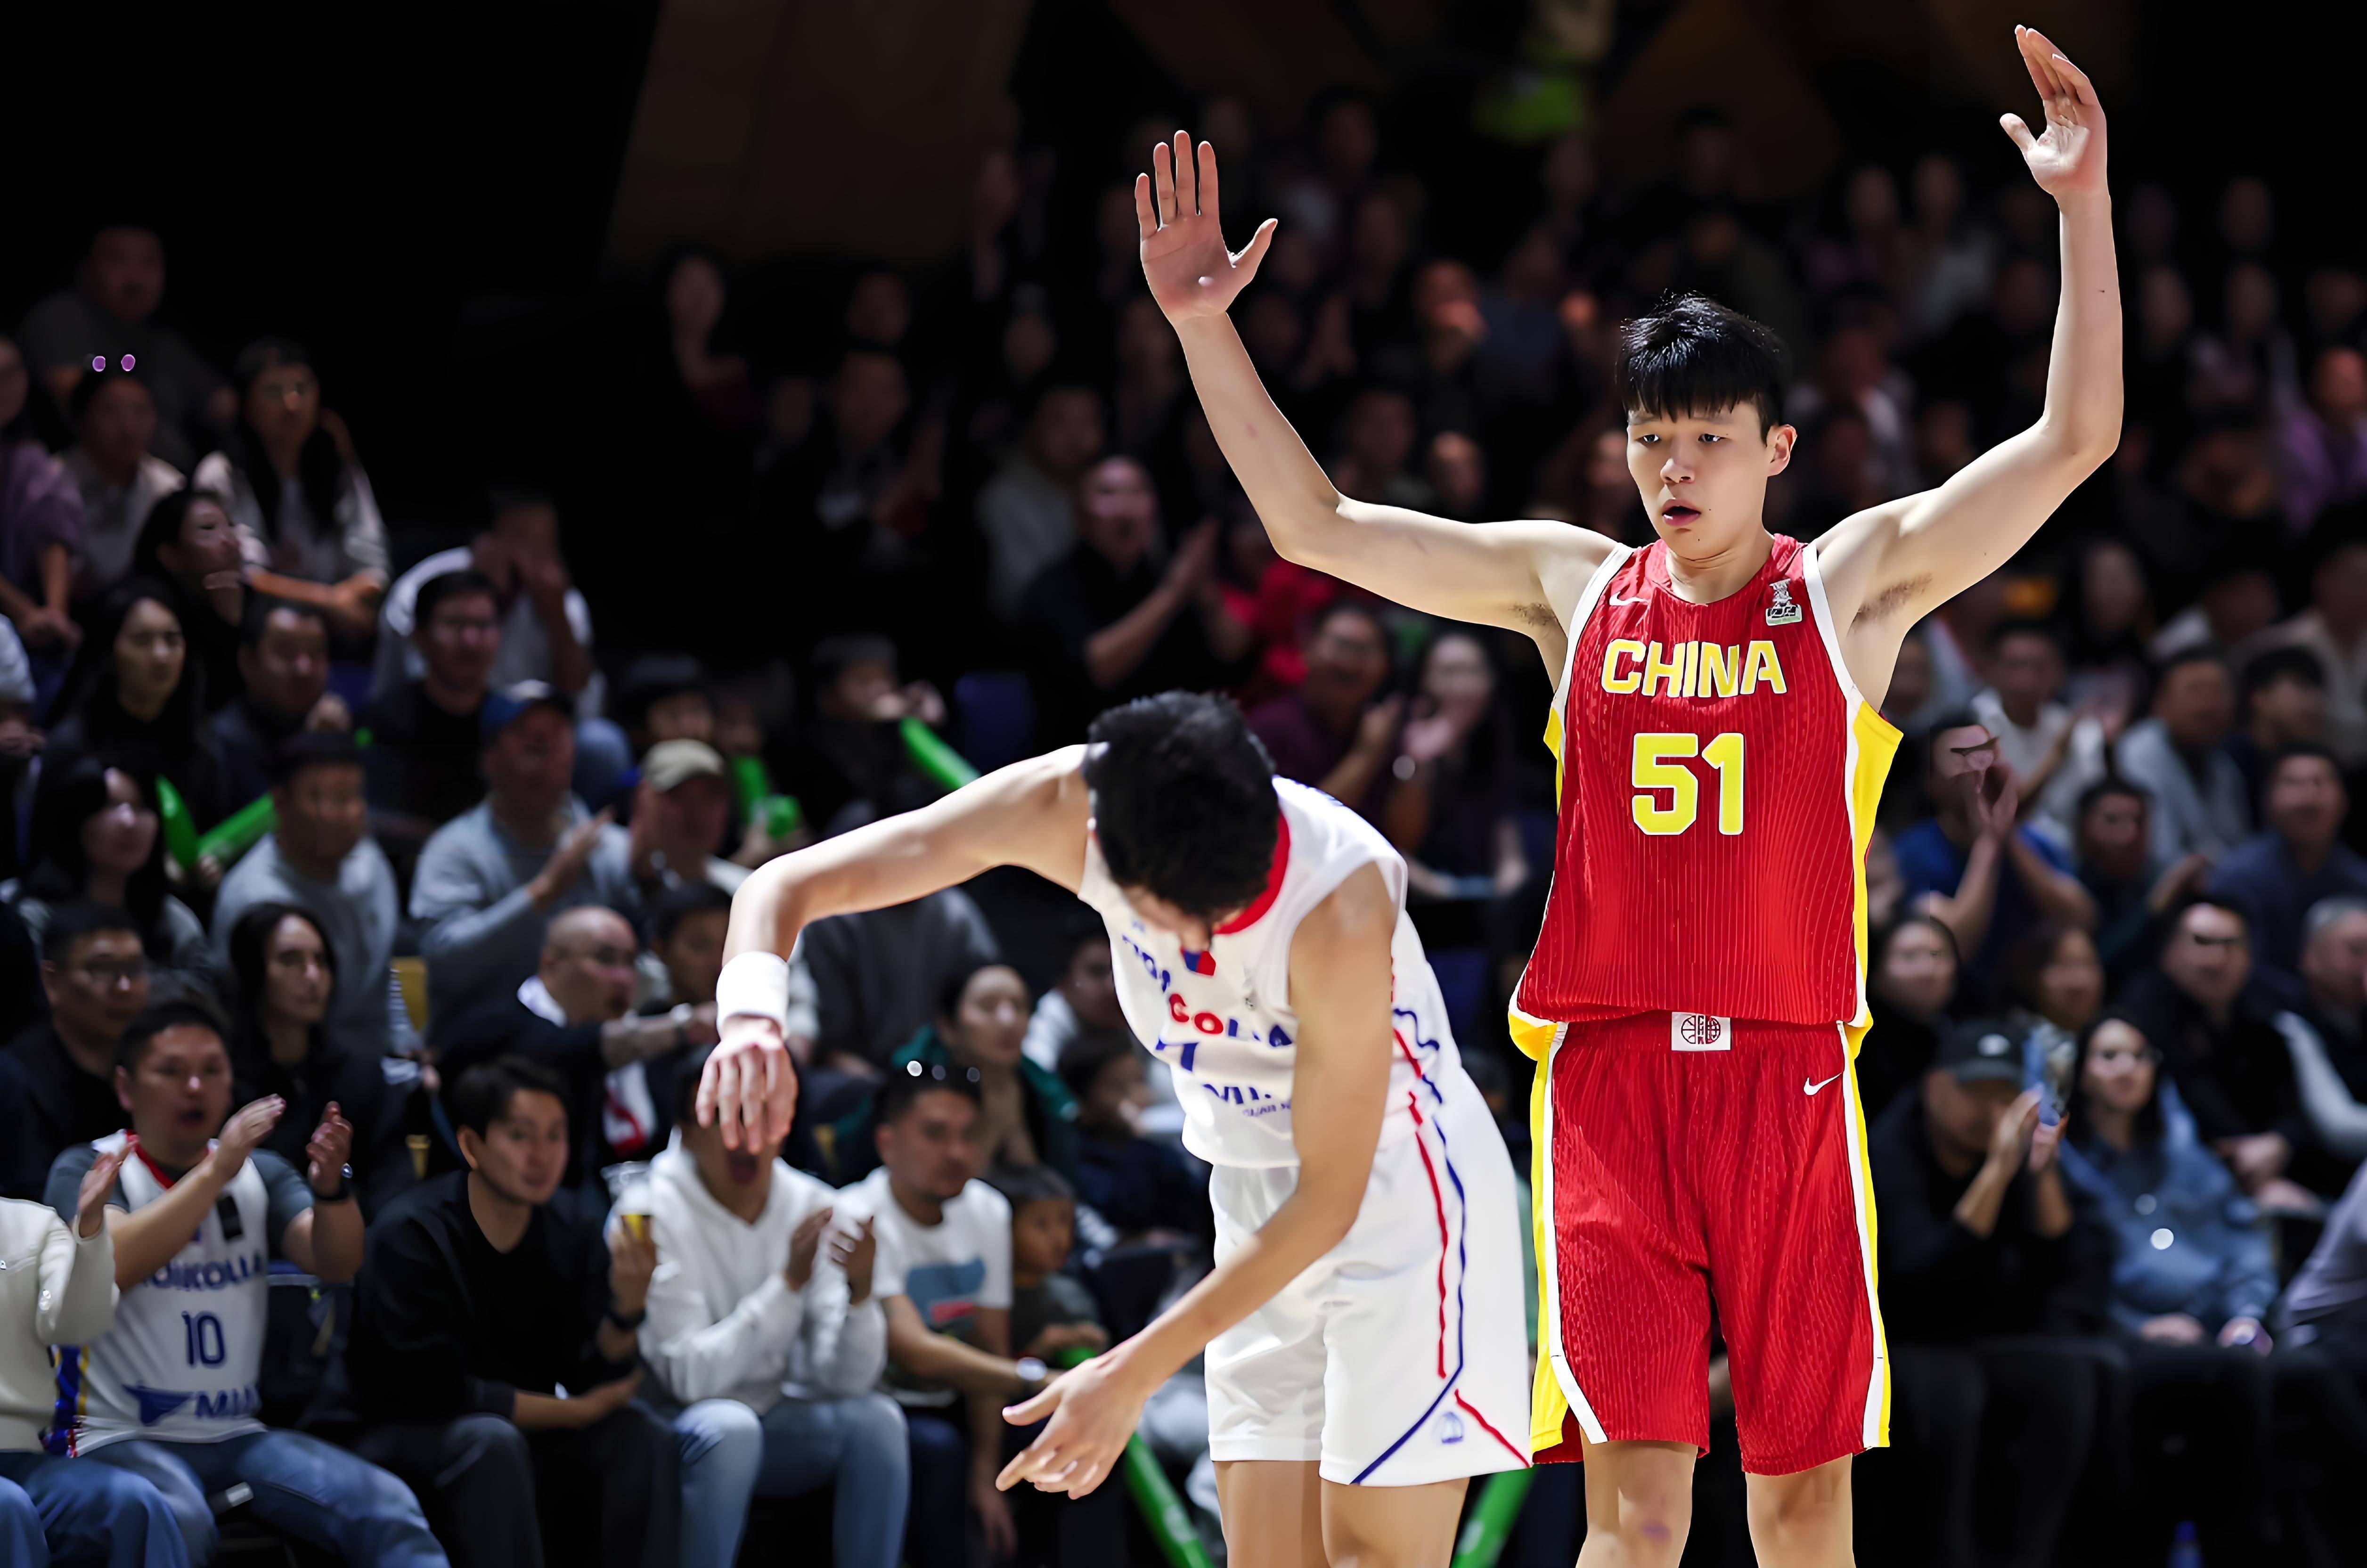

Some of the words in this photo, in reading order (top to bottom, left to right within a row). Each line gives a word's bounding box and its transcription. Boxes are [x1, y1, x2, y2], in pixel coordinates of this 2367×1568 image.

[1601, 638, 1787, 698] CHINA
[1632, 733, 1744, 835] 51
[181, 1311, 226, 1366] 10
